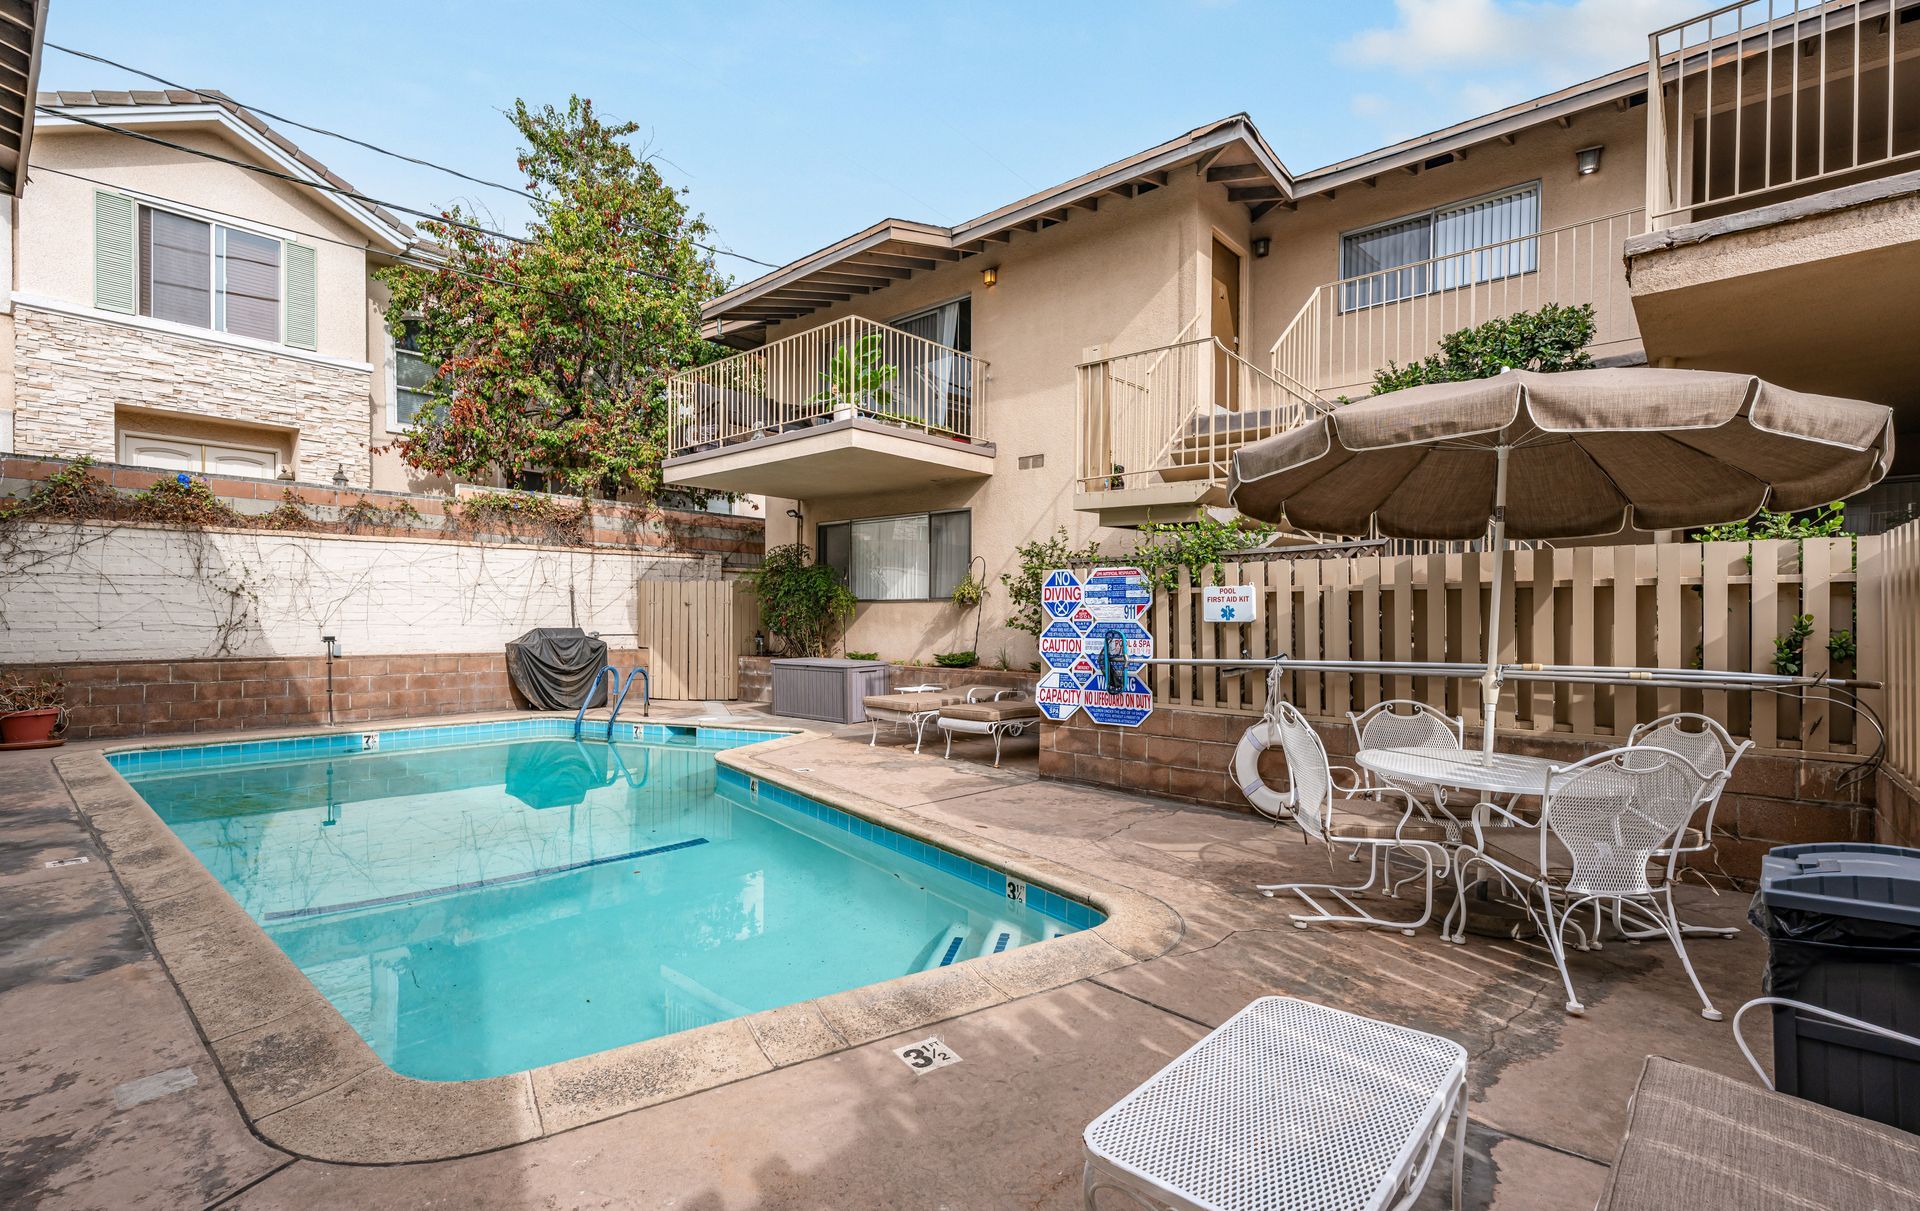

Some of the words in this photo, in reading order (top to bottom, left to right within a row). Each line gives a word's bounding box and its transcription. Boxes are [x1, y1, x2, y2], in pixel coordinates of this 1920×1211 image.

[1055, 572, 1070, 586] NO
[1044, 587, 1082, 601] DIVING
[1124, 605, 1136, 619] 911
[1042, 639, 1082, 652] CAUTION
[1138, 640, 1151, 648] SPA
[1060, 681, 1076, 689] POOL
[1039, 688, 1082, 704] CAPACITY
[1084, 691, 1093, 704] NO
[1094, 692, 1124, 707] LIFEGUARD
[1125, 694, 1135, 708] ON
[1136, 695, 1151, 709] DUTY
[634, 726, 639, 734] 7
[363, 735, 371, 744] 7
[1007, 881, 1016, 900] 3
[902, 1048, 933, 1068] 3
